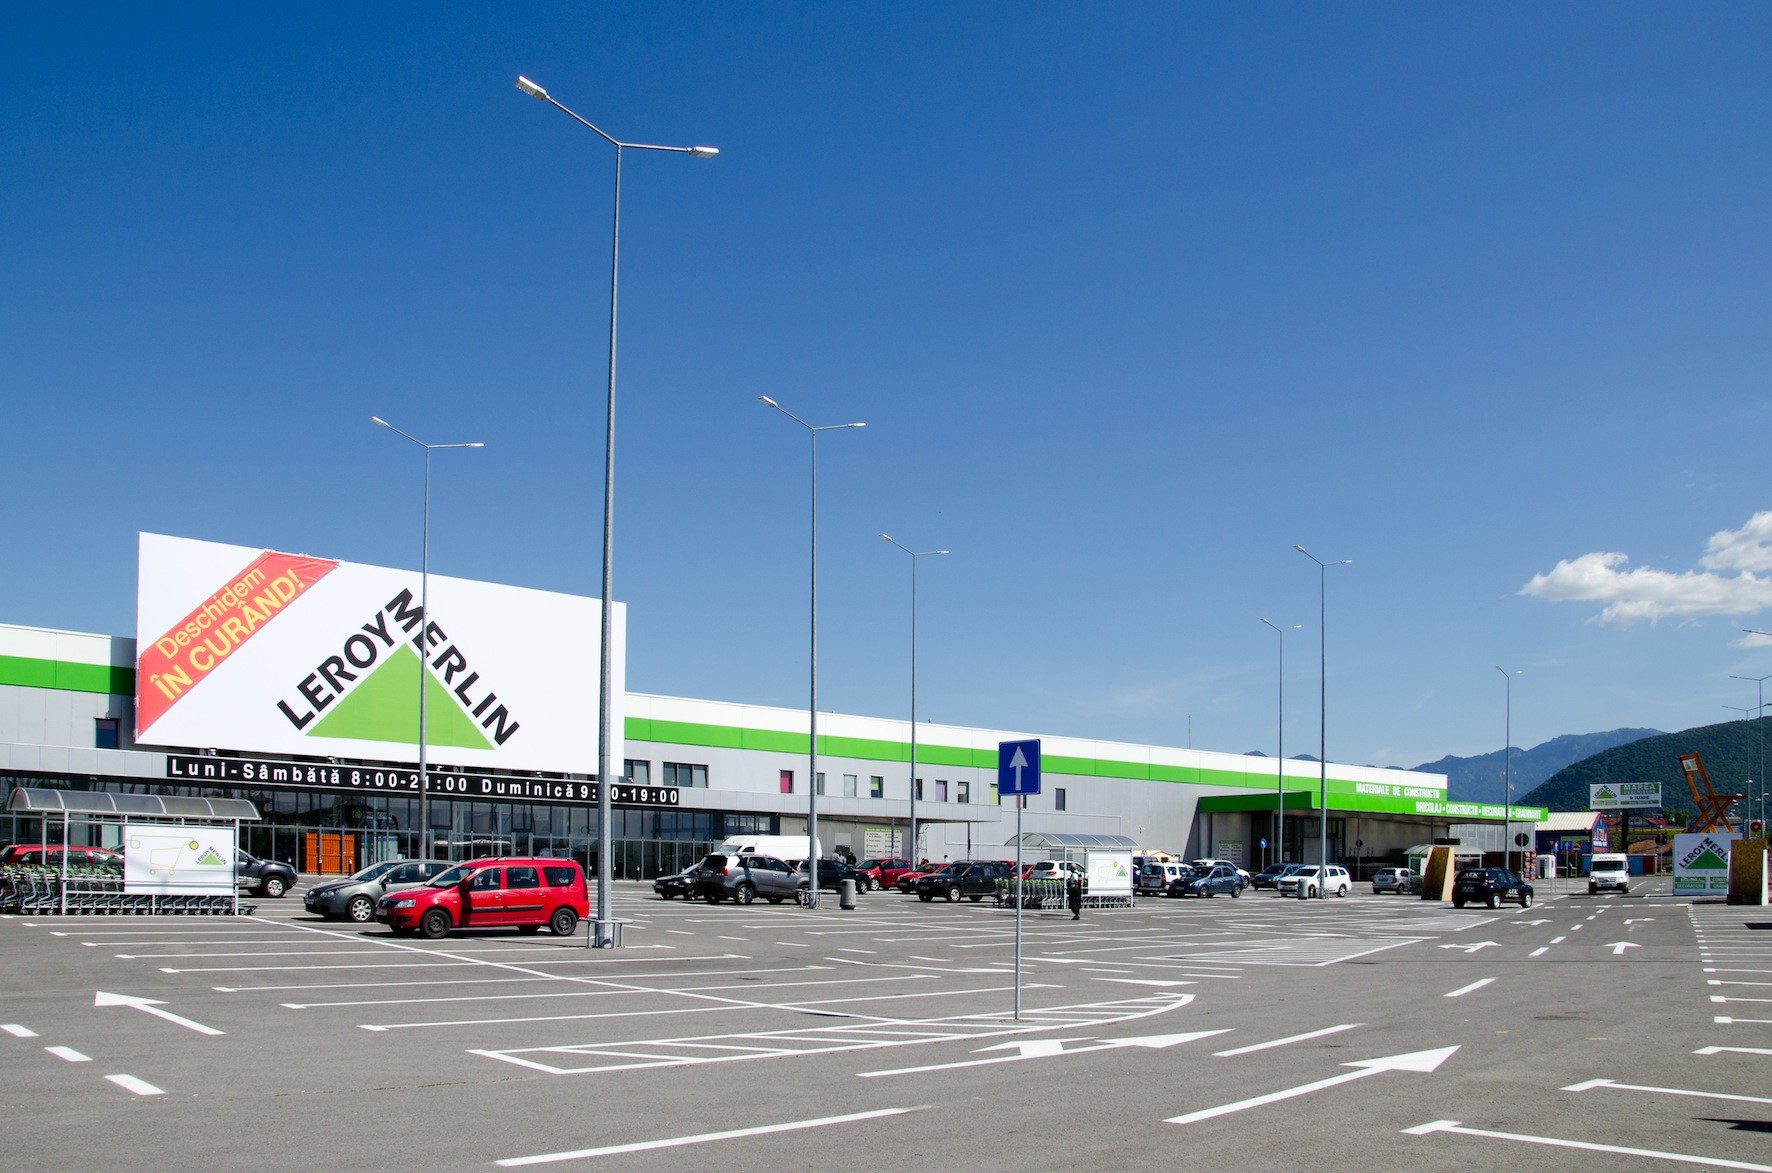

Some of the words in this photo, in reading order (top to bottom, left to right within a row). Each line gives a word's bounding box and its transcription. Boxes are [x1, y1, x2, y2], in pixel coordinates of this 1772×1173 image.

[155, 568, 266, 660] Deschidem
[150, 664, 193, 701] ÎN
[189, 568, 305, 672] CURÂND!
[276, 610, 395, 731] LEROY
[384, 587, 520, 746] MERLIN
[171, 758, 340, 784] Luni-Sâmbătă
[351, 770, 467, 793] 8:00-21:00
[482, 778, 573, 798] Duminică
[581, 785, 677, 804] 9:0-19:00
[1356, 782, 1389, 795] MATERIALE
[1393, 786, 1400, 796] DE
[1416, 801, 1442, 813] BRICOLAJ
[195, 848, 210, 864] LEROY
[209, 846, 227, 865] MERLIN
[1678, 842, 1706, 869] LEROY
[1703, 837, 1727, 863] MERL
